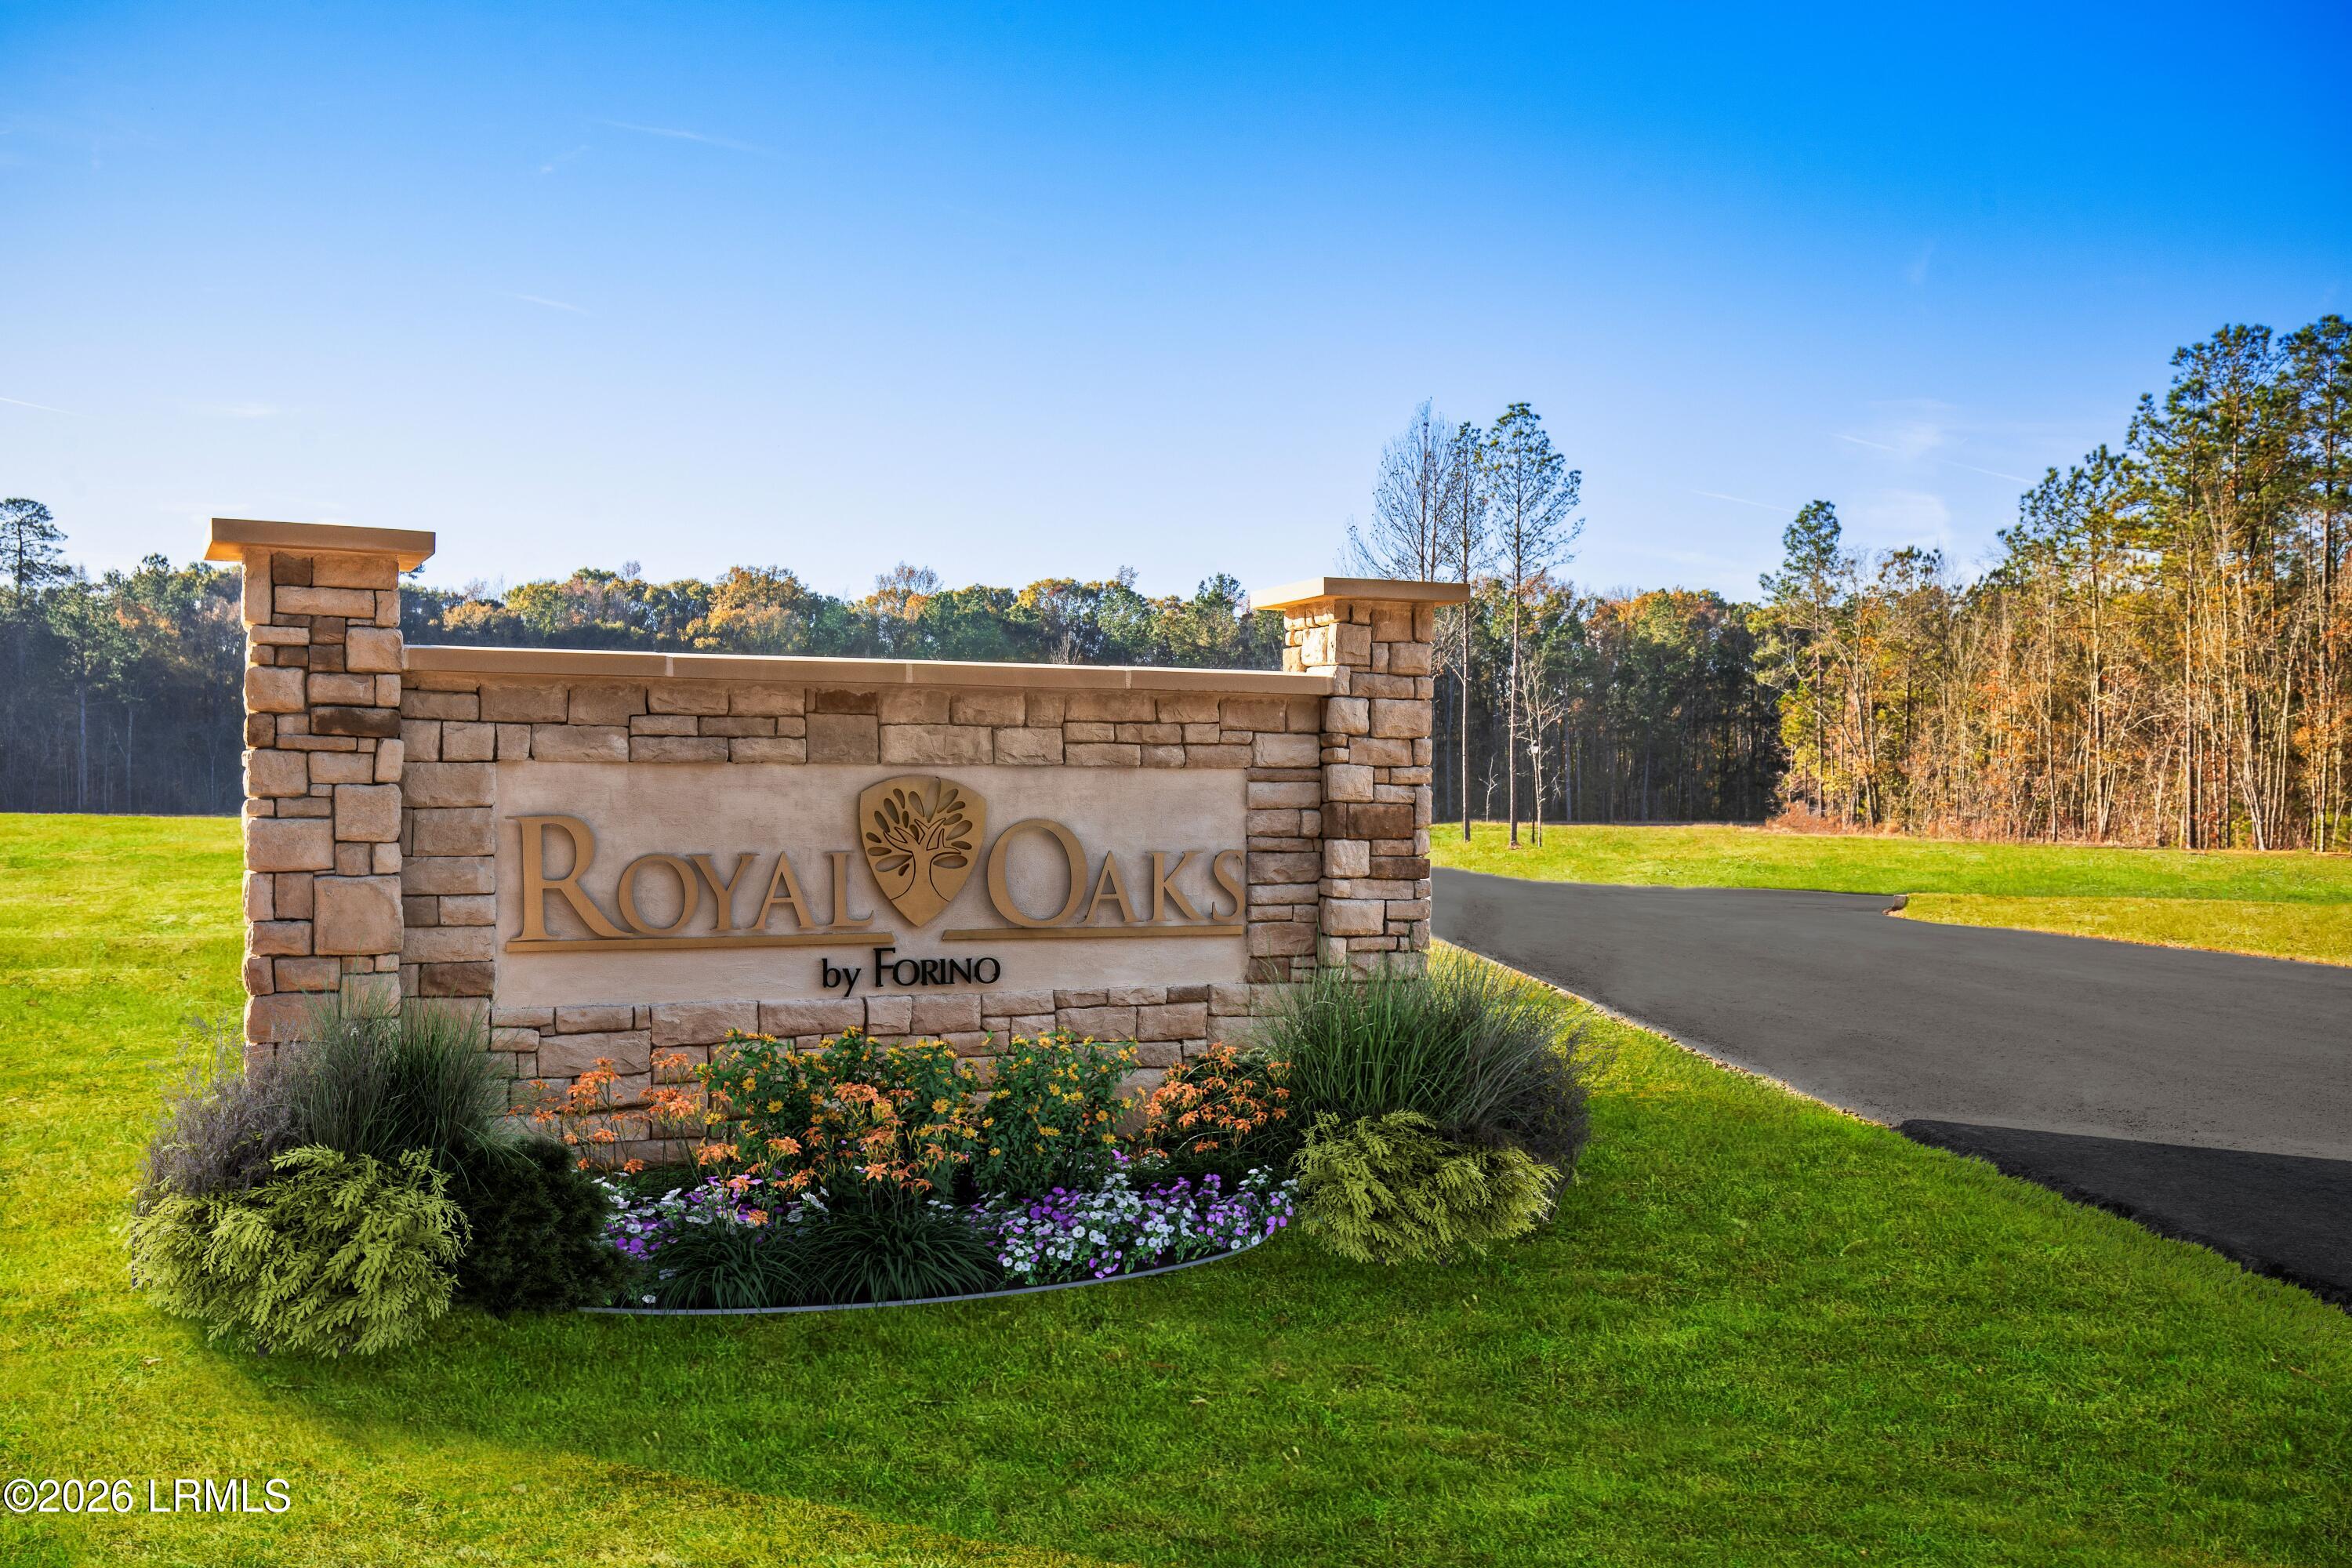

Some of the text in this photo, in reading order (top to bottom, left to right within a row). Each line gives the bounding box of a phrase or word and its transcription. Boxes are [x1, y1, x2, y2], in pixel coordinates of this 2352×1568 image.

[505, 815, 1246, 941] ROYAL OAKS
[821, 946, 1001, 997] by FORINO
